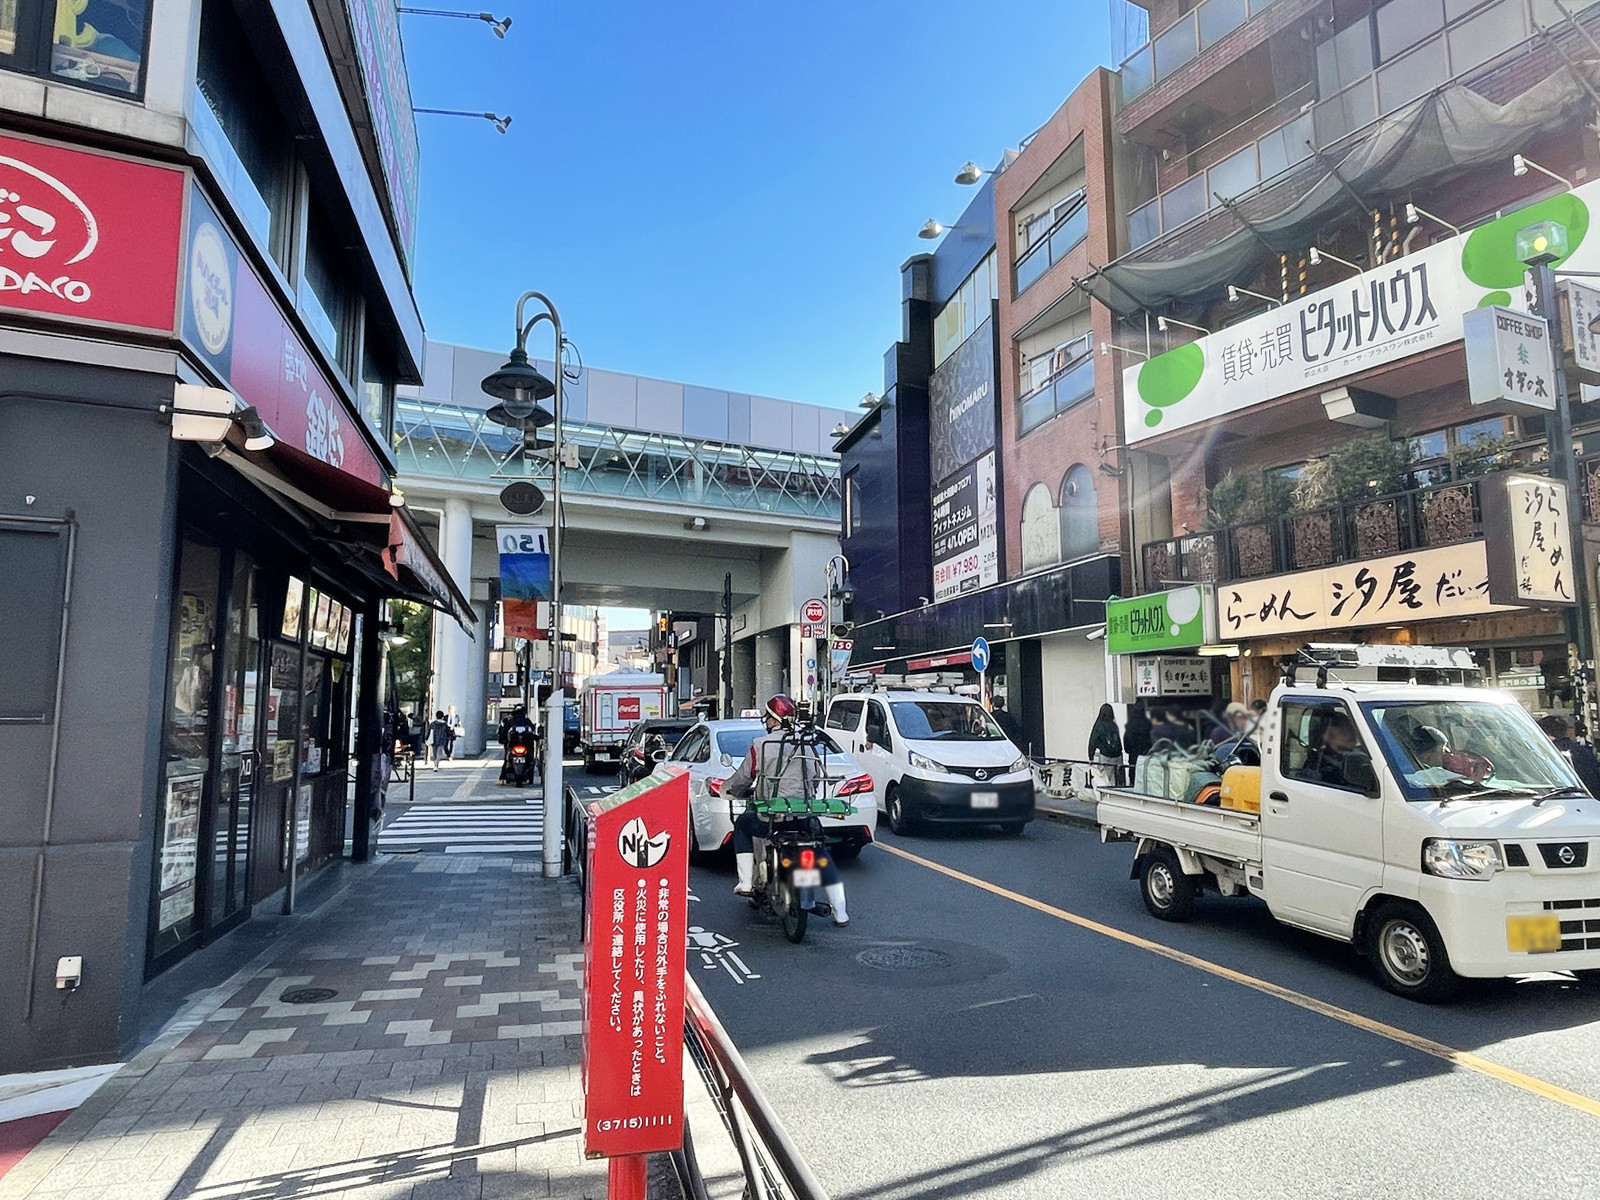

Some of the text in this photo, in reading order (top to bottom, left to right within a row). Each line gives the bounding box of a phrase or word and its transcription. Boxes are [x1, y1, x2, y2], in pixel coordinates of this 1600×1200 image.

[1221, 262, 1438, 385] 賃貸・売買 ピタットハウス
[1497, 315, 1543, 340] COFFEE SHOP
[957, 523, 977, 547] OPEN
[1524, 486, 1546, 552] 汐屋
[1547, 486, 1571, 600] らーめん
[1130, 605, 1165, 635] ピタットハウス
[1228, 589, 1317, 630] らーめん
[1330, 560, 1423, 622] 汐屋
[833, 641, 852, 650] 150
[609, 888, 625, 1032] 区役所へ連絡してください。
[654, 888, 670, 1064] 非常の場合以外手をふれないこと。
[597, 1114, 672, 1133] (3715)1111
